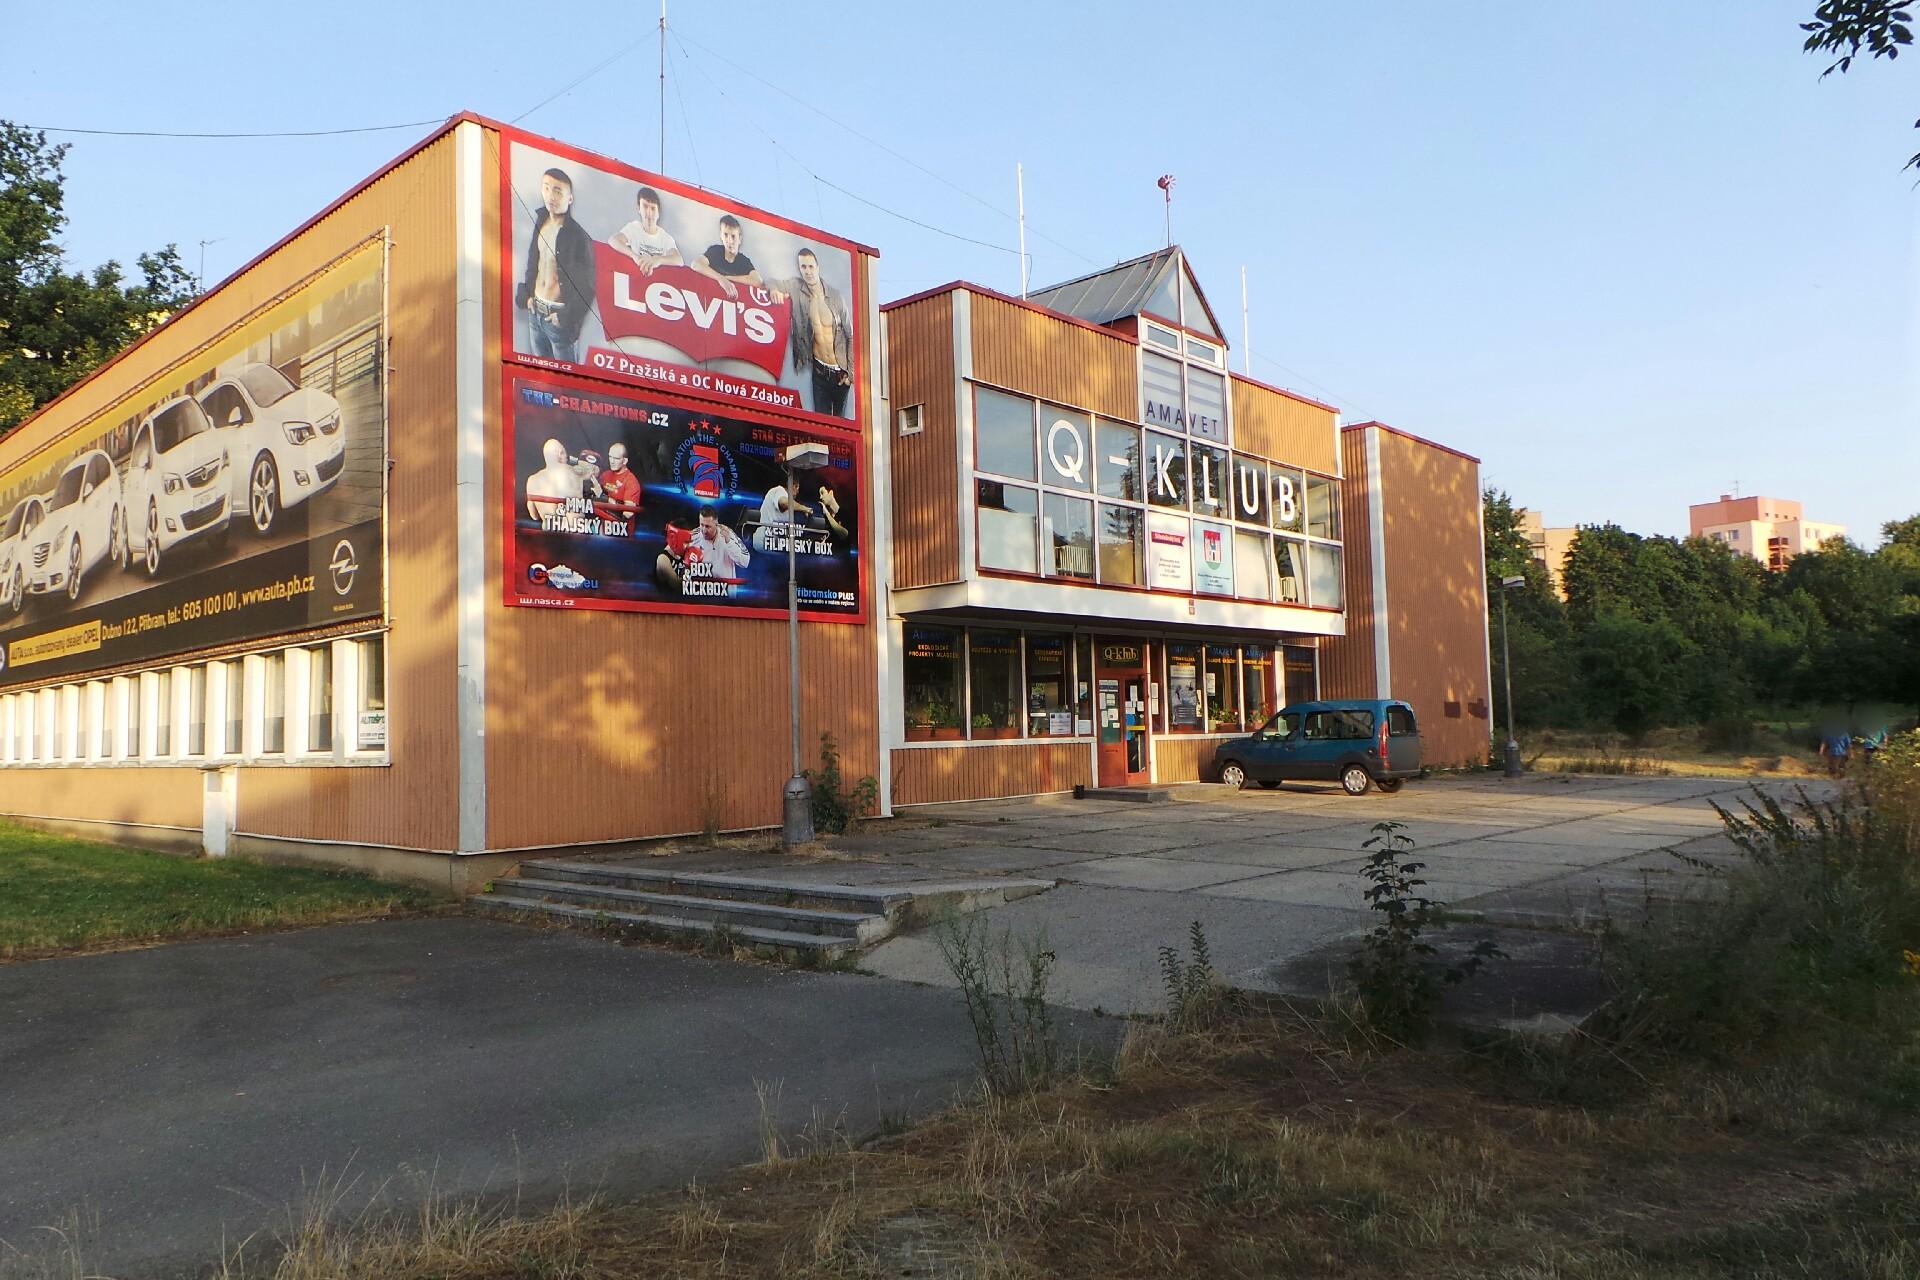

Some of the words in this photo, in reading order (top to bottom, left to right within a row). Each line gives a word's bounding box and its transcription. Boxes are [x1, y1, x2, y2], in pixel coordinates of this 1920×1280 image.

[594, 352, 615, 369] OZ
[619, 357, 676, 383] Pražská
[680, 374, 688, 384] a
[692, 374, 711, 390] OC
[715, 378, 748, 397] Nová
[751, 386, 795, 407] Zdaboř
[1147, 399, 1218, 436] AMAVET
[698, 433, 715, 445] THE
[566, 497, 594, 514] MMA
[544, 514, 601, 535] THAJSKÝ
[604, 520, 629, 537] BOX
[814, 541, 833, 556] BOX
[690, 562, 713, 578] BOX
[682, 580, 728, 597] KICKBOX
[838, 591, 855, 601] PLUS
[183, 600, 201, 622] 605
[203, 595, 221, 616] 100
[241, 575, 316, 607] www.auta.pb.cz
